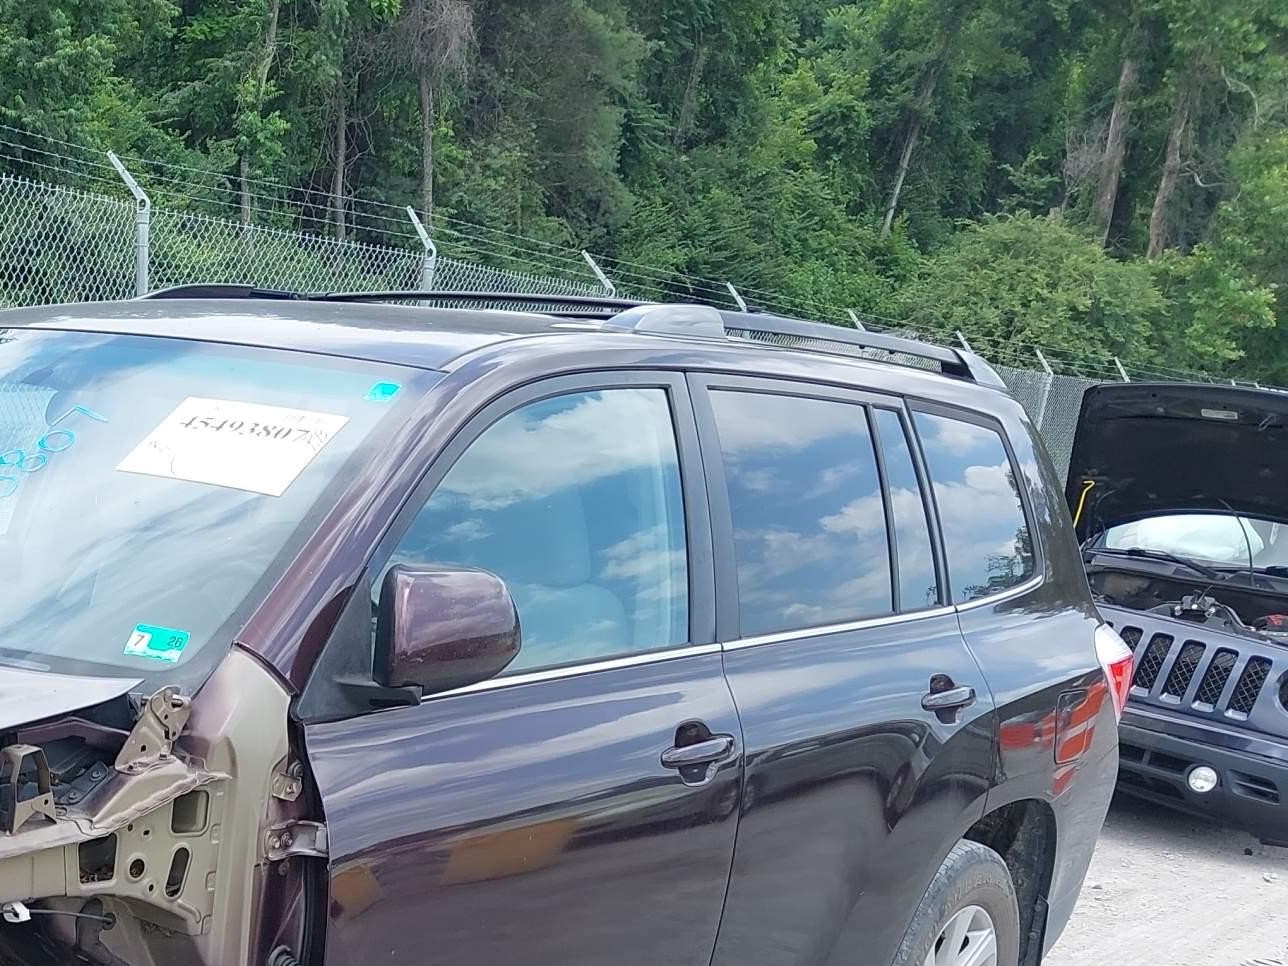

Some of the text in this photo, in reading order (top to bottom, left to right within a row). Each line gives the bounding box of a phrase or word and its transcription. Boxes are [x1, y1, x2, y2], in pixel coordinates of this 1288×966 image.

[179, 414, 311, 443] 45493807
[134, 634, 184, 648] 7 26
